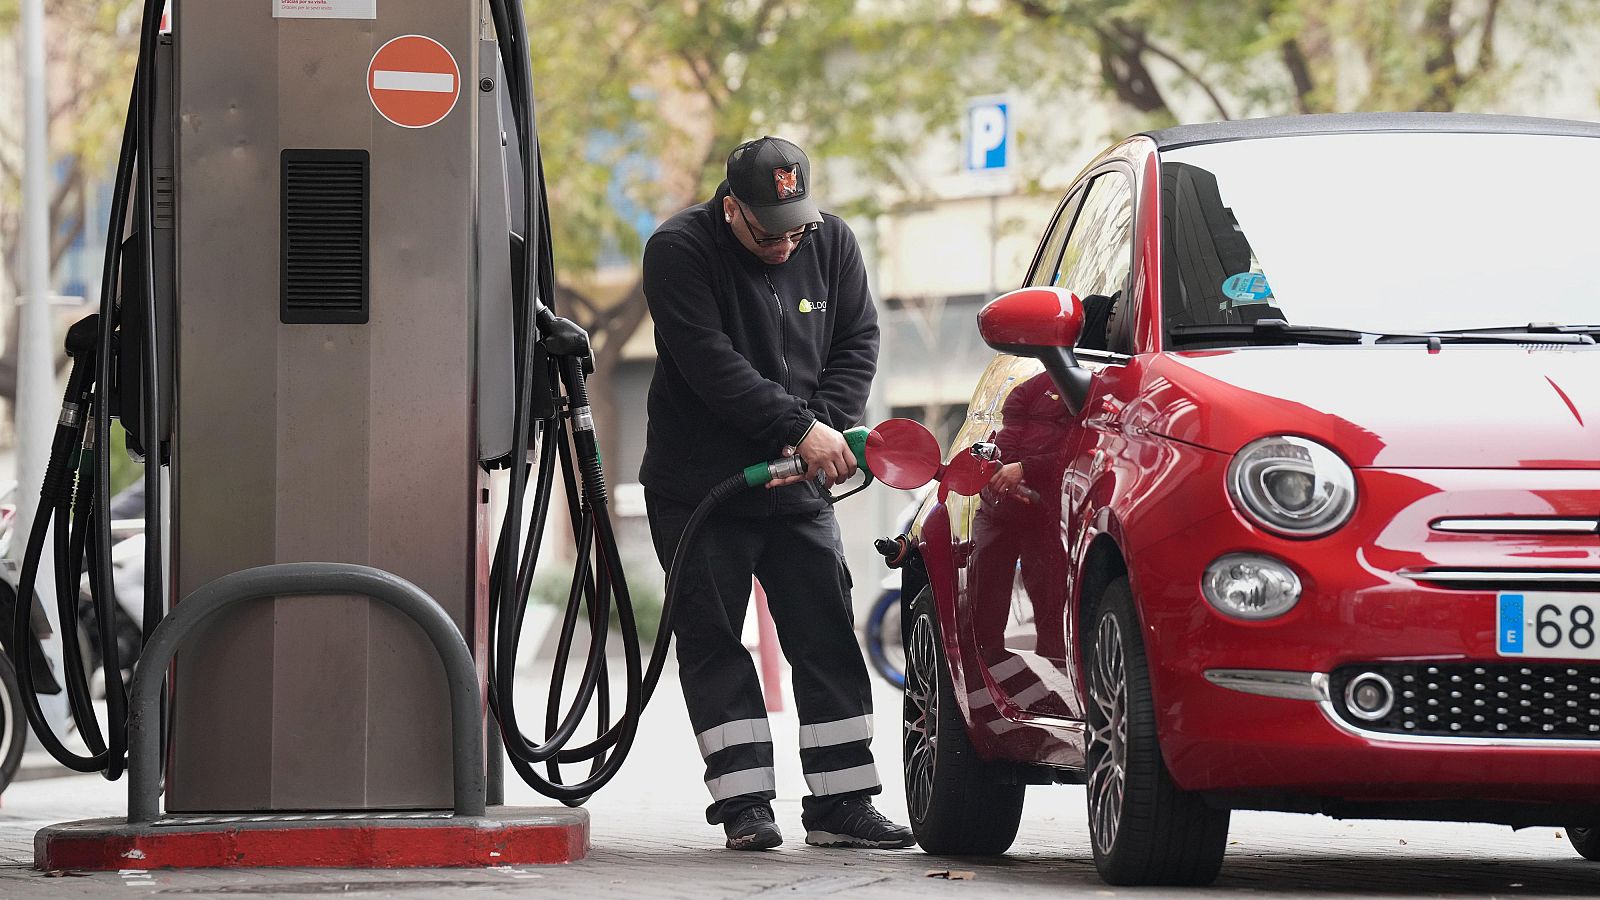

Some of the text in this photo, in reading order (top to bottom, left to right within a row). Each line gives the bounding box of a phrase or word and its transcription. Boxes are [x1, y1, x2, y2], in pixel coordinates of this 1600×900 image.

[971, 105, 1006, 169] P
[1507, 603, 1595, 650] E 68
